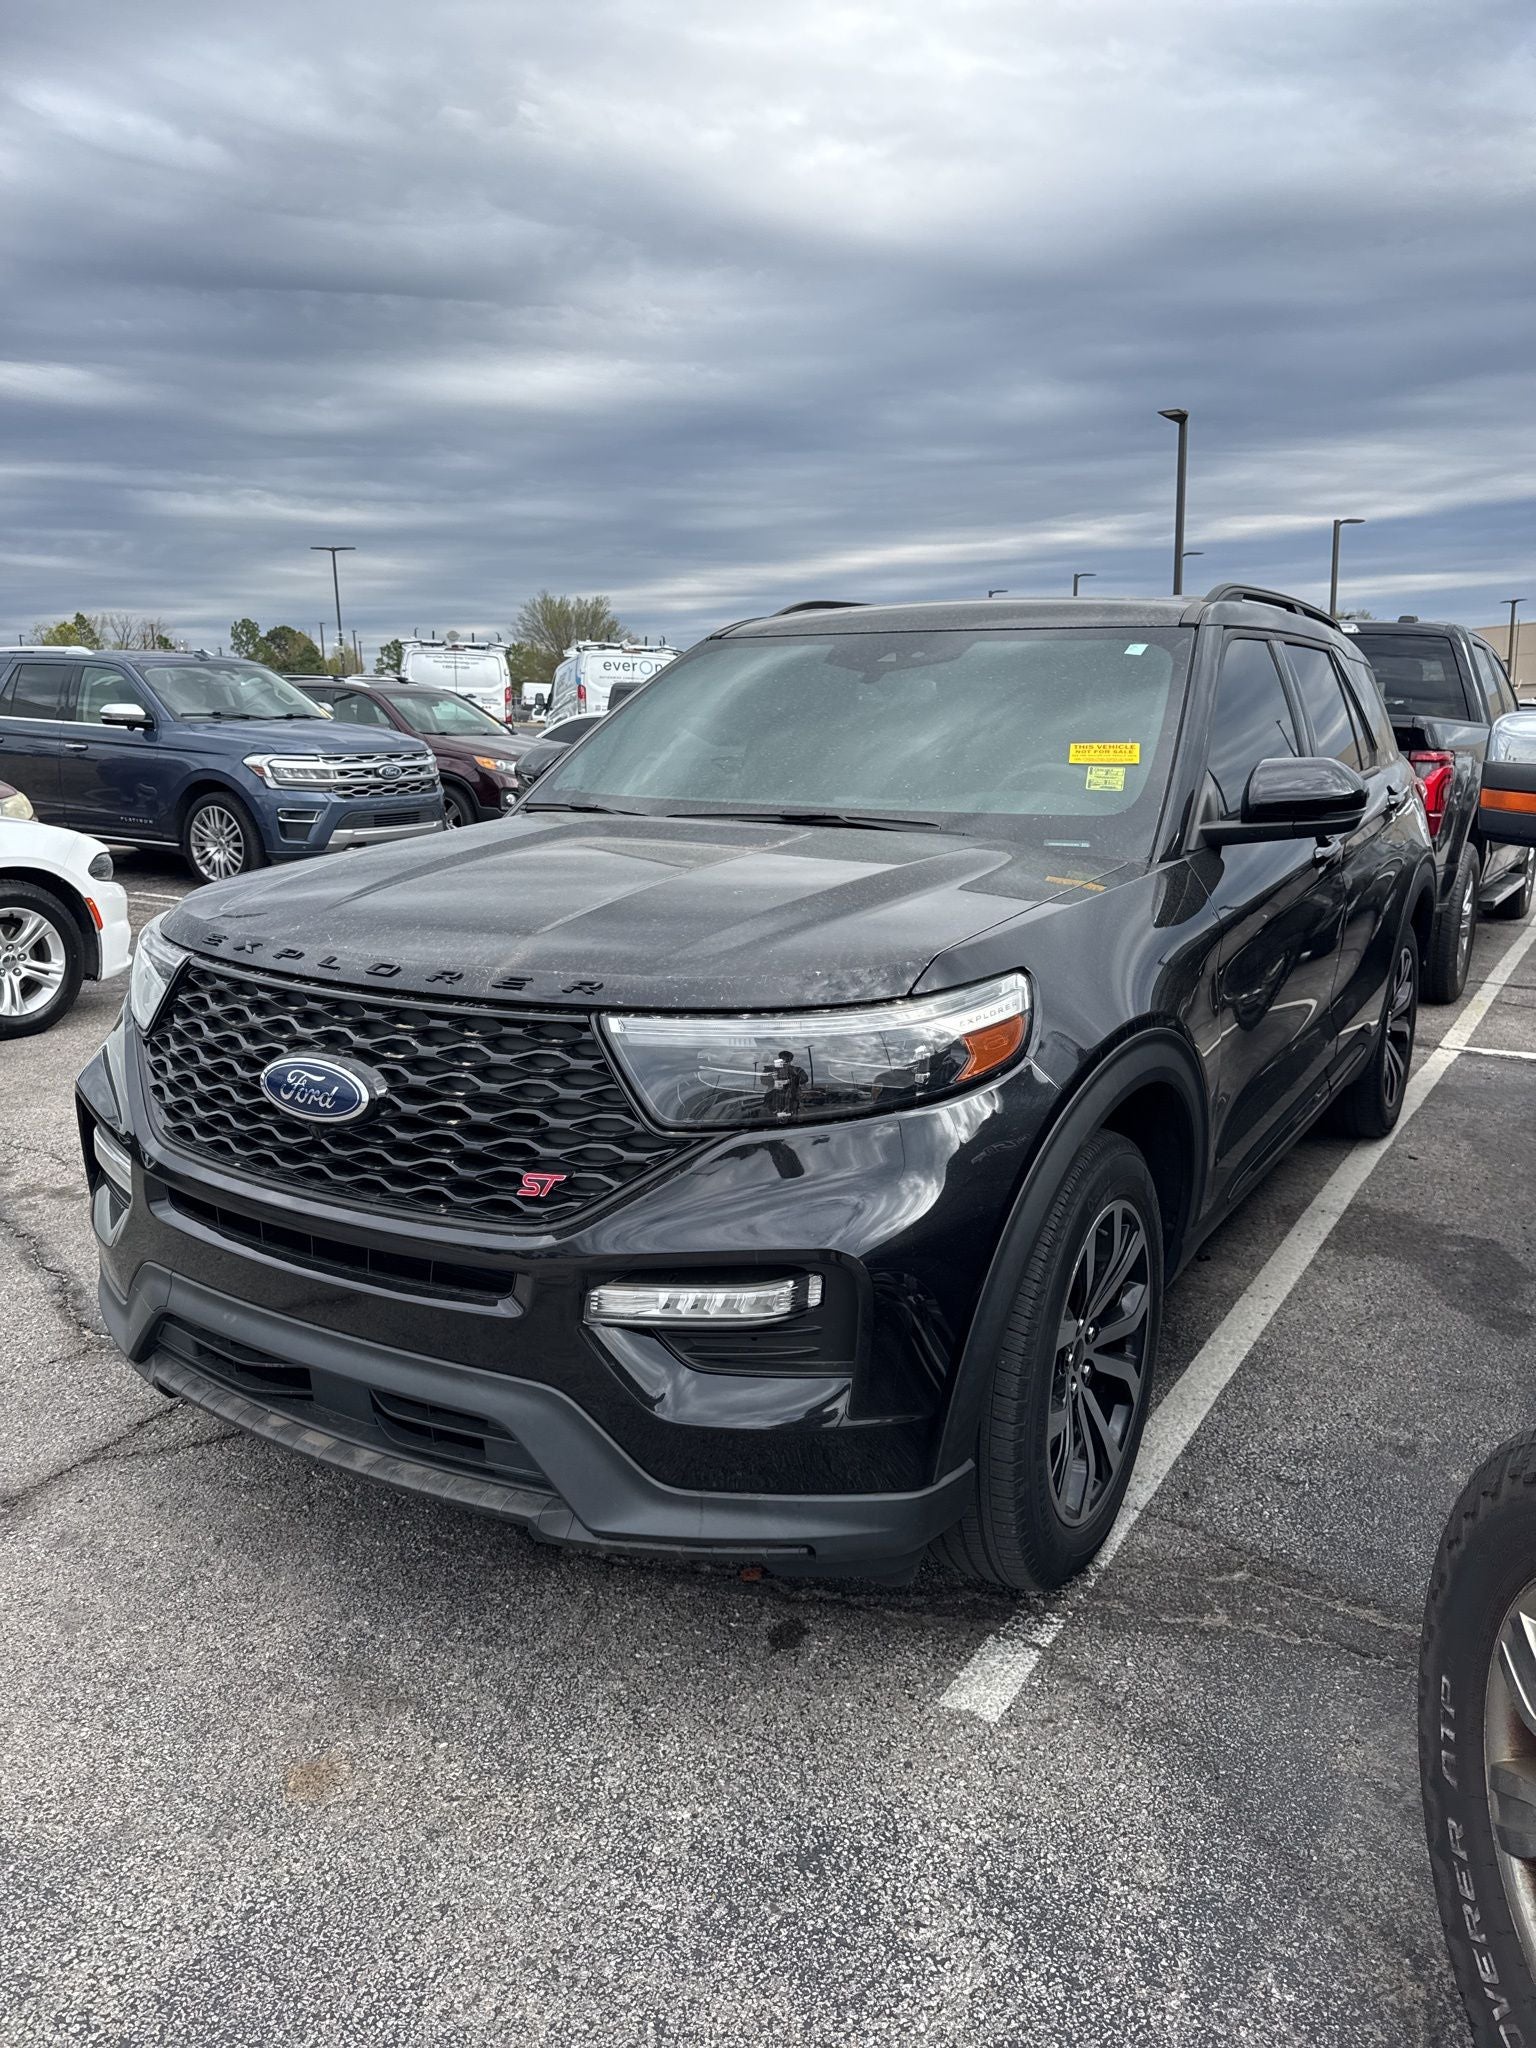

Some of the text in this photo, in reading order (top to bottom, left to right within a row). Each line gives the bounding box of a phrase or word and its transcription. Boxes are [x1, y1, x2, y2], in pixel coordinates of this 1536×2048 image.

[202, 932, 604, 996] EXPLORER
[960, 1001, 1018, 1027] EXPLORER
[280, 1069, 339, 1109] Ford
[517, 1173, 567, 1197] ST
